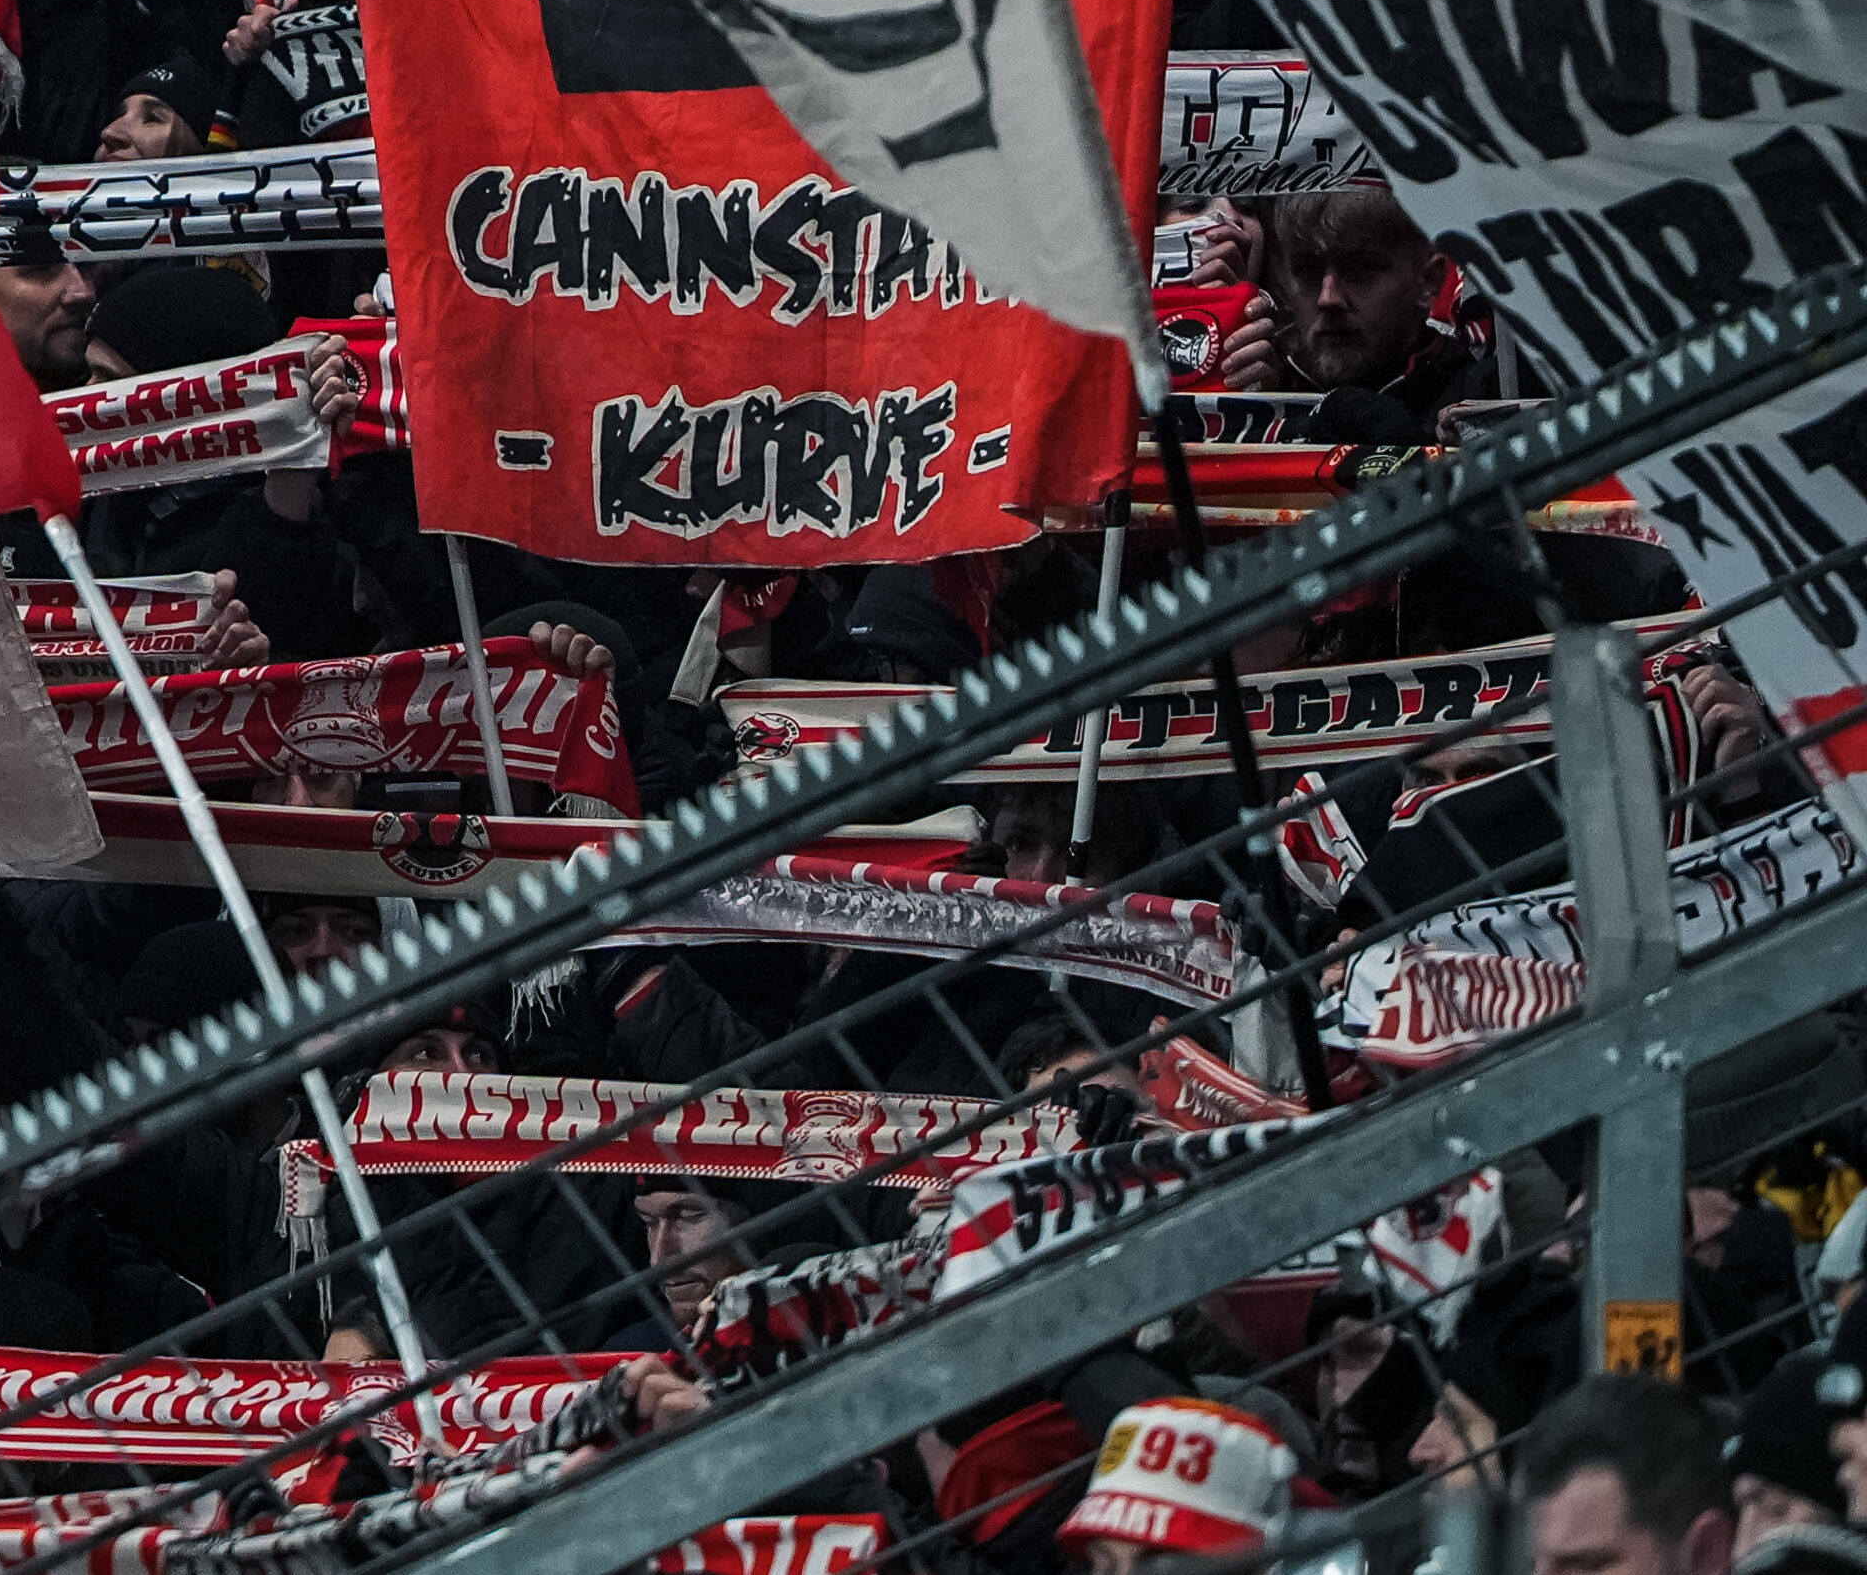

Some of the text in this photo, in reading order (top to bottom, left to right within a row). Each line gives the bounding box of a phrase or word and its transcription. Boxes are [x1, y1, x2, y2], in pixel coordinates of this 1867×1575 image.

[447, 165, 1032, 322] CANNSTA
[593, 380, 957, 539] KURVE
[398, 855, 481, 882] KURVE
[1135, 1423, 1217, 1487] 93
